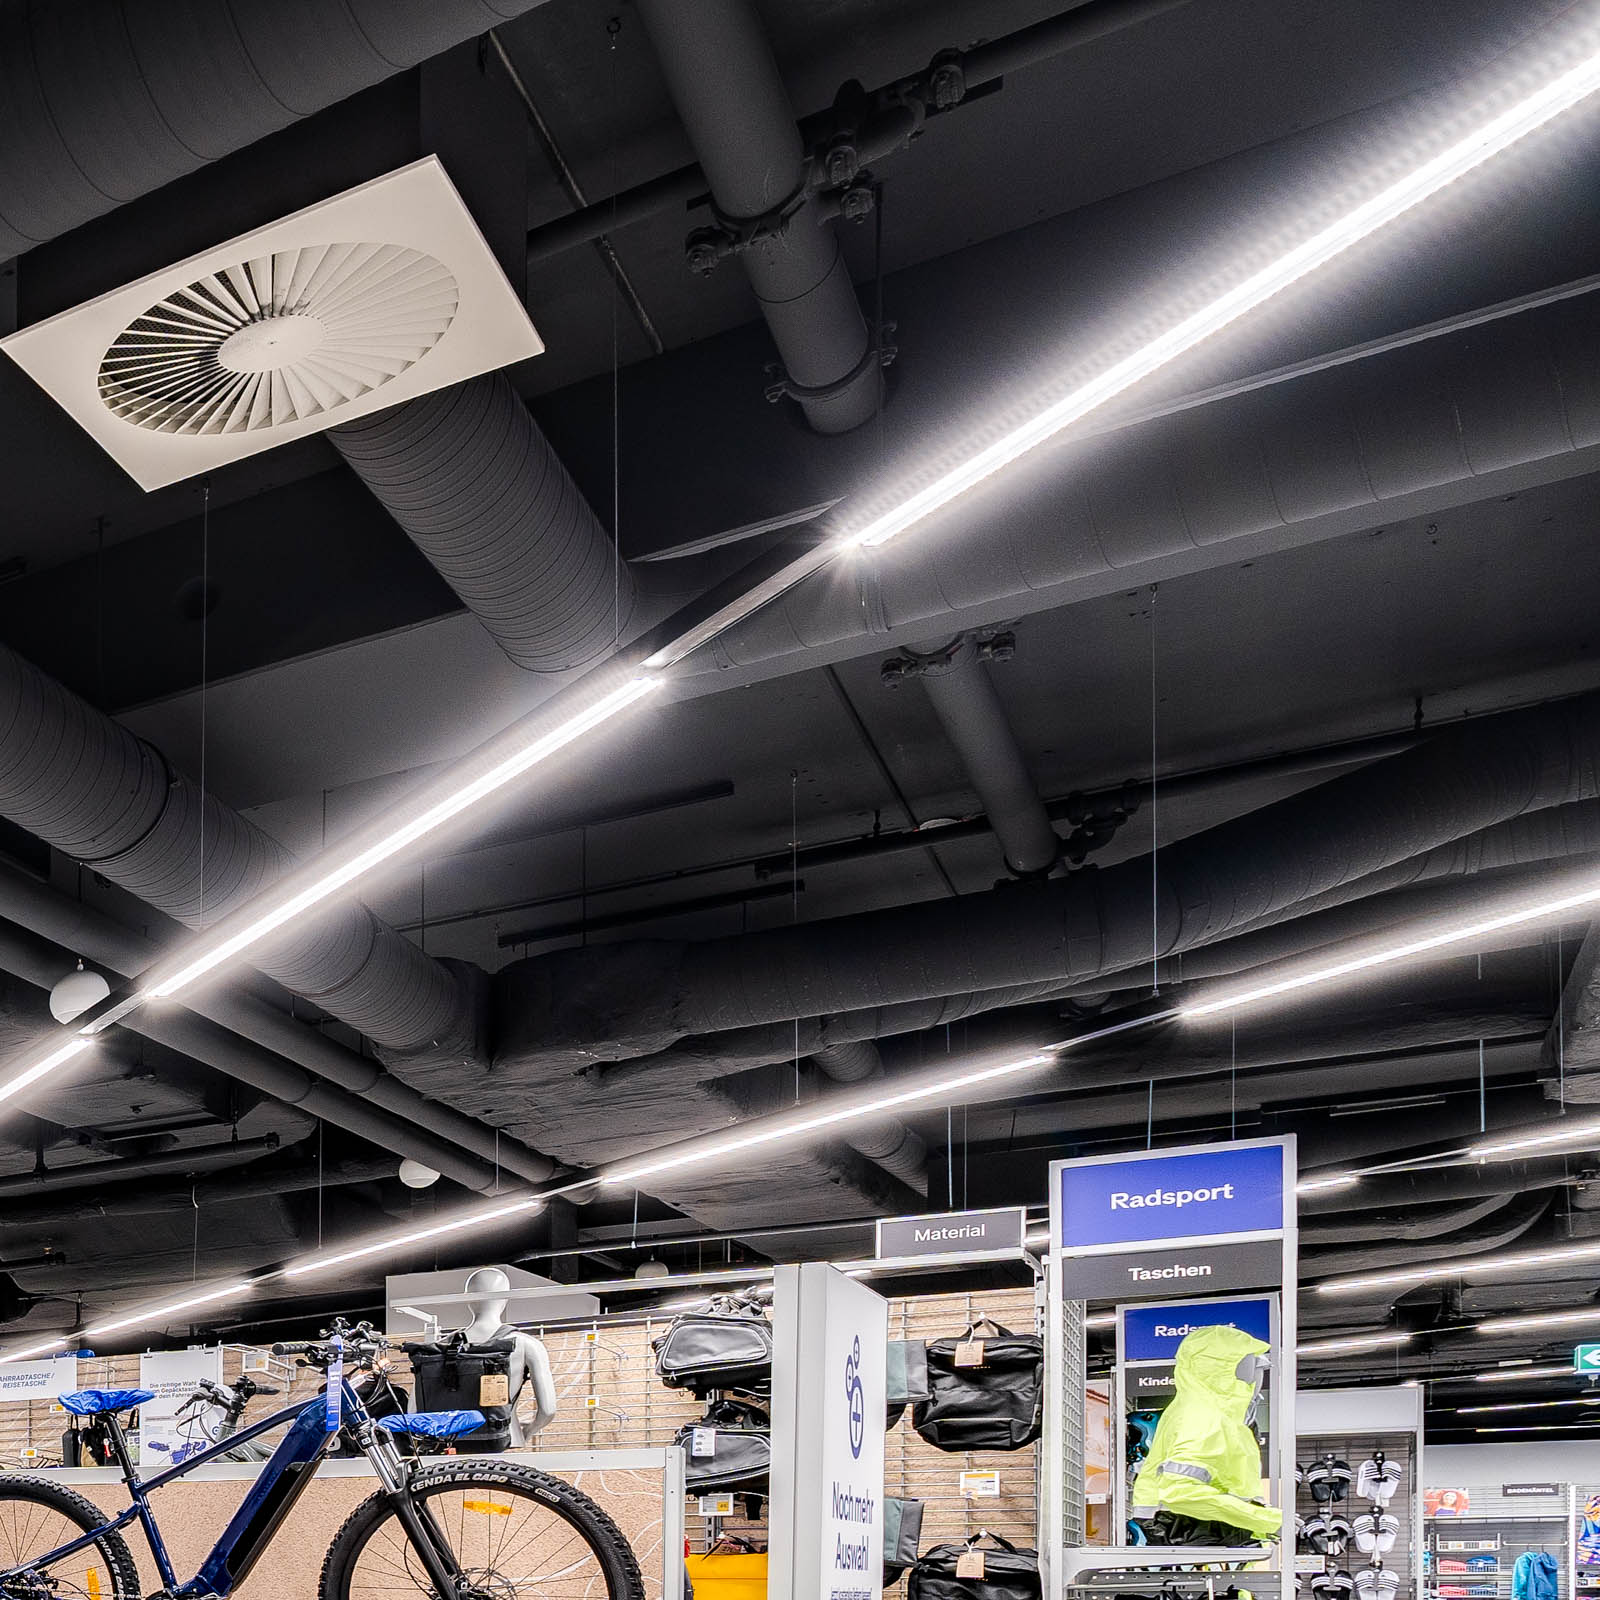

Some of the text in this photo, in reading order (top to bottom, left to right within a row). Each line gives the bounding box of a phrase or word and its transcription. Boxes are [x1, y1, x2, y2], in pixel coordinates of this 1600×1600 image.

[1110, 1183, 1234, 1210] Radsport
[914, 1224, 986, 1242] Material
[1128, 1263, 1212, 1282] Taschen
[2, 1380, 48, 1389] REISETASCHE
[454, 1472, 470, 1481] EL
[471, 1472, 508, 1484] CAPO
[832, 1480, 875, 1525] Noch mehr
[834, 1532, 870, 1574] Auswahl
